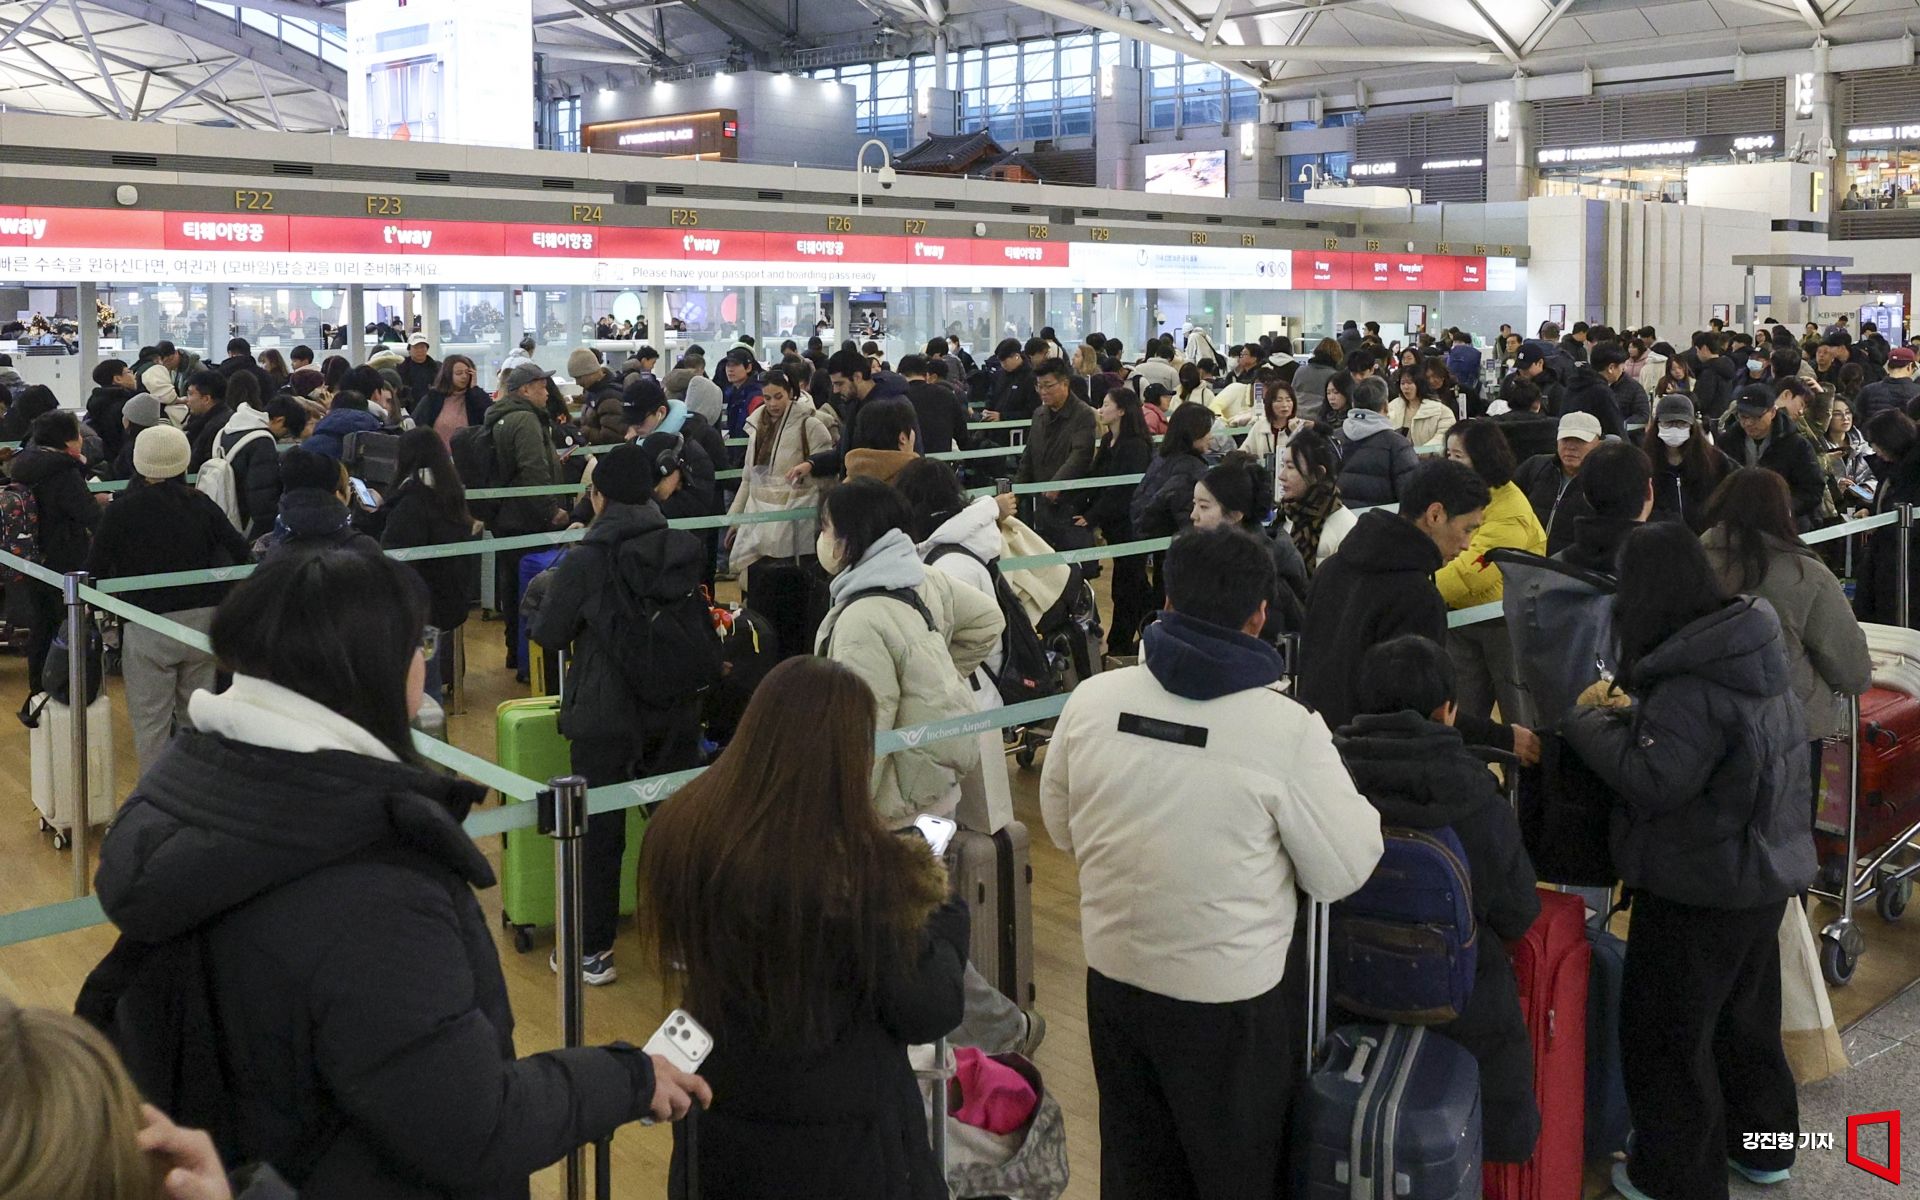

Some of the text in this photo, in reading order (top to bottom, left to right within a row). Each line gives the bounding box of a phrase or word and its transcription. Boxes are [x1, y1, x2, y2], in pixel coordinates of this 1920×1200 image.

[235, 190, 275, 210] F22
[1812, 171, 1824, 213] F
[366, 196, 402, 215] F23
[572, 205, 603, 222] F24
[671, 209, 698, 226] F25
[827, 216, 851, 231] F26
[183, 221, 264, 242] 티웨이항공
[905, 220, 926, 234] F27
[1028, 225, 1048, 239] F28
[1091, 228, 1109, 241] F29
[383, 225, 432, 248] t'way
[532, 232, 593, 250] 티웨이항공
[683, 235, 720, 255] t'way
[1191, 232, 1207, 244] F30
[1241, 233, 1256, 246] F31
[1325, 238, 1338, 250] F32
[796, 240, 844, 256] 티웨이항공
[1367, 240, 1379, 252] F33
[34, 257, 82, 273] 수속을
[88, 257, 169, 275] 원하신다면,
[174, 259, 216, 275] 여권과
[334, 261, 359, 276] 미리
[632, 266, 876, 282] Please have your passport and boarding pass ready
[926, 718, 991, 741] Incheon Airport
